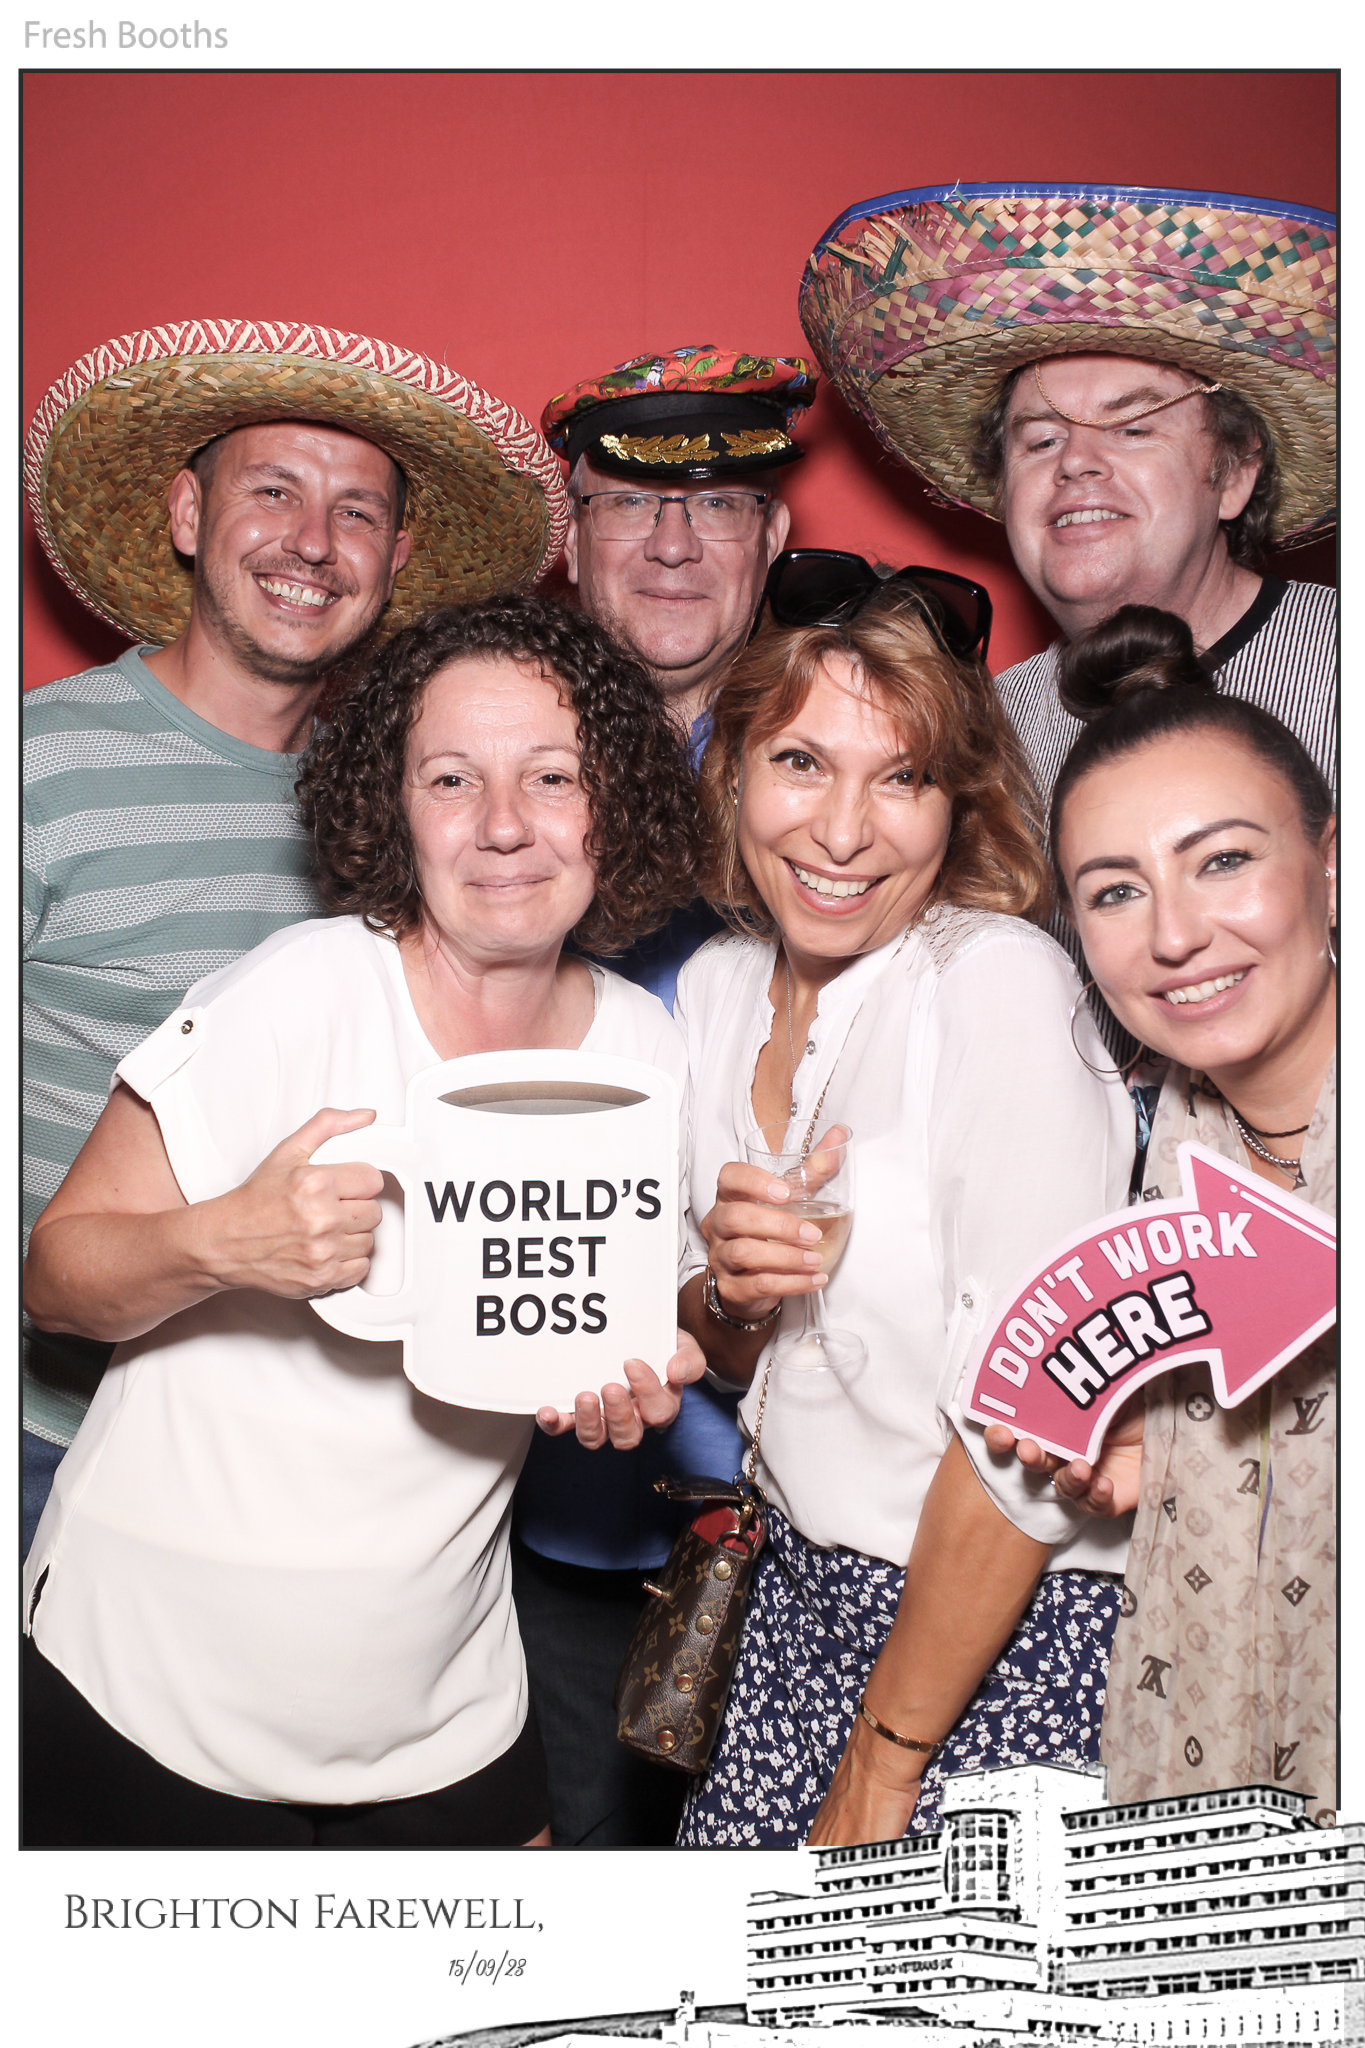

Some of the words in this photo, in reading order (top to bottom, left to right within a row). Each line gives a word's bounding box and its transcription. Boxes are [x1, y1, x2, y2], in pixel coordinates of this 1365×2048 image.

[424, 1178, 662, 1223] WORLD'S
[482, 1236, 607, 1279] BEST
[1097, 1211, 1258, 1280] WORK
[476, 1292, 608, 1337] BOSS
[988, 1255, 1094, 1389] DON'T
[1042, 1270, 1212, 1410] HERE
[978, 1391, 1018, 1418] I
